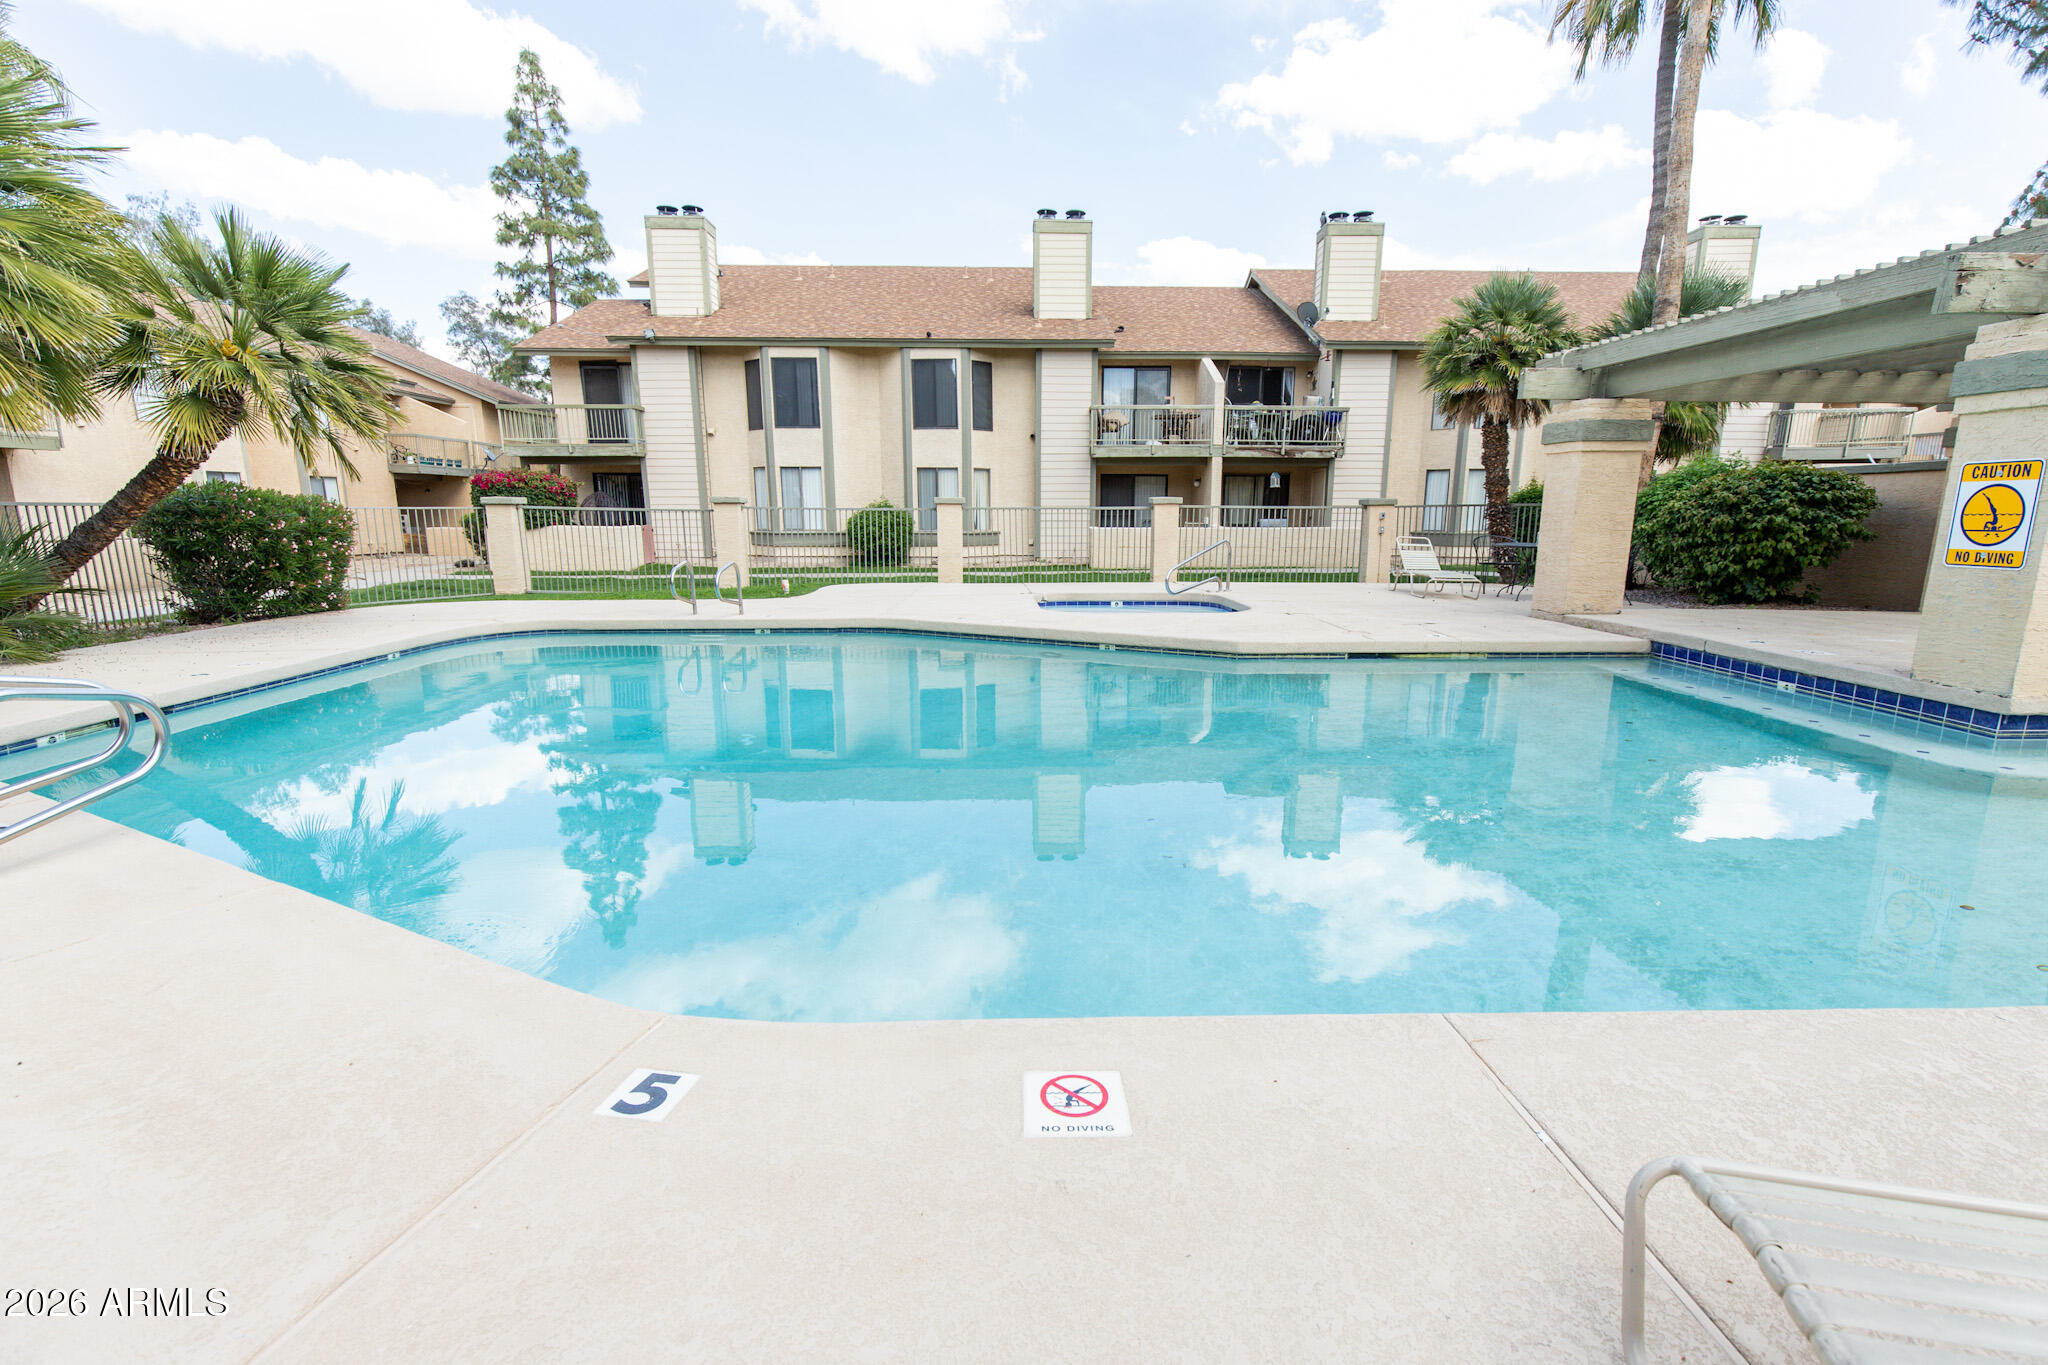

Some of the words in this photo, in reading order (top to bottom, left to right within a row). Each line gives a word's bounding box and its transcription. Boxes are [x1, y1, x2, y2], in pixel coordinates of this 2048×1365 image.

[1972, 464, 2032, 479] CAUTION
[1954, 551, 1970, 563] NO
[610, 1072, 682, 1115] 5
